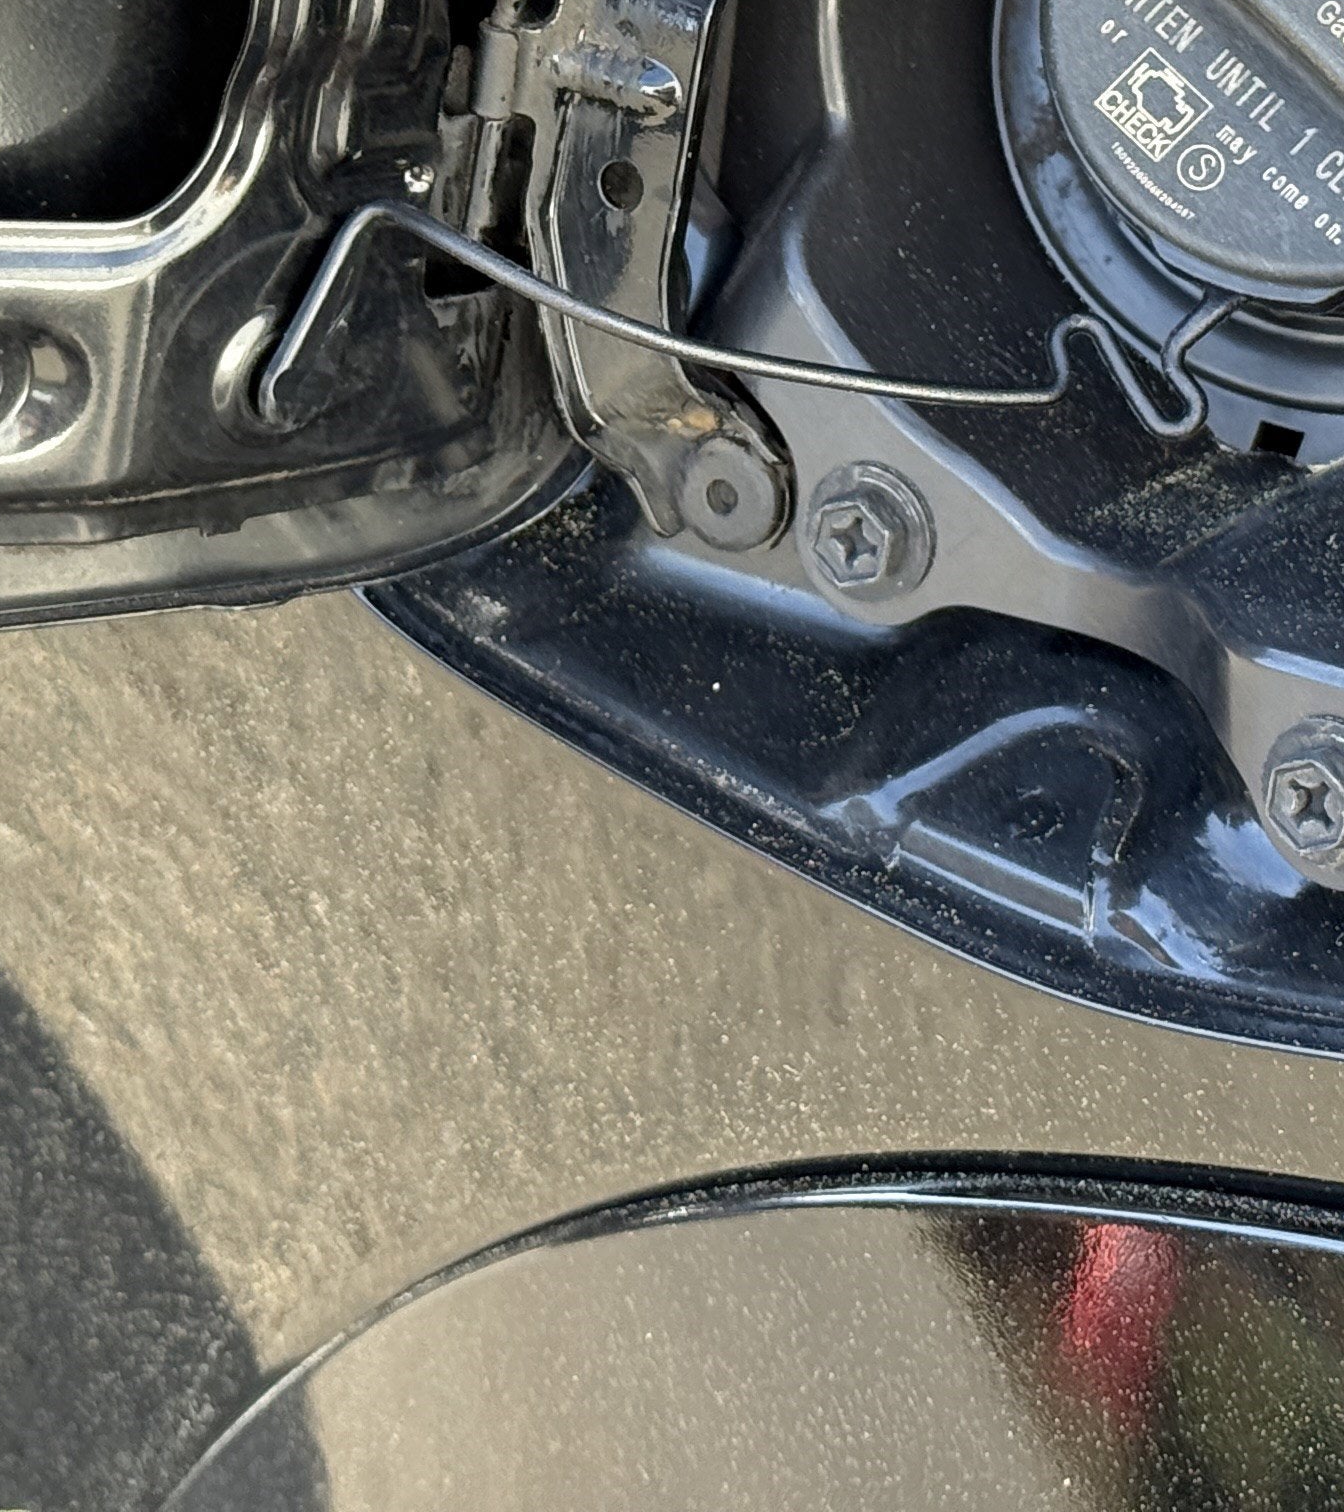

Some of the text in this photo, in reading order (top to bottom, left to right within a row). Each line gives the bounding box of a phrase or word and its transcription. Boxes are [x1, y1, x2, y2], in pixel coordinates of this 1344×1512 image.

[1100, 19, 1129, 44] or
[1100, 89, 1172, 162] CHECK
[1206, 48, 1286, 133] UNTIL
[1289, 127, 1319, 156] 1
[1215, 124, 1258, 166] may
[1262, 165, 1310, 210] come
